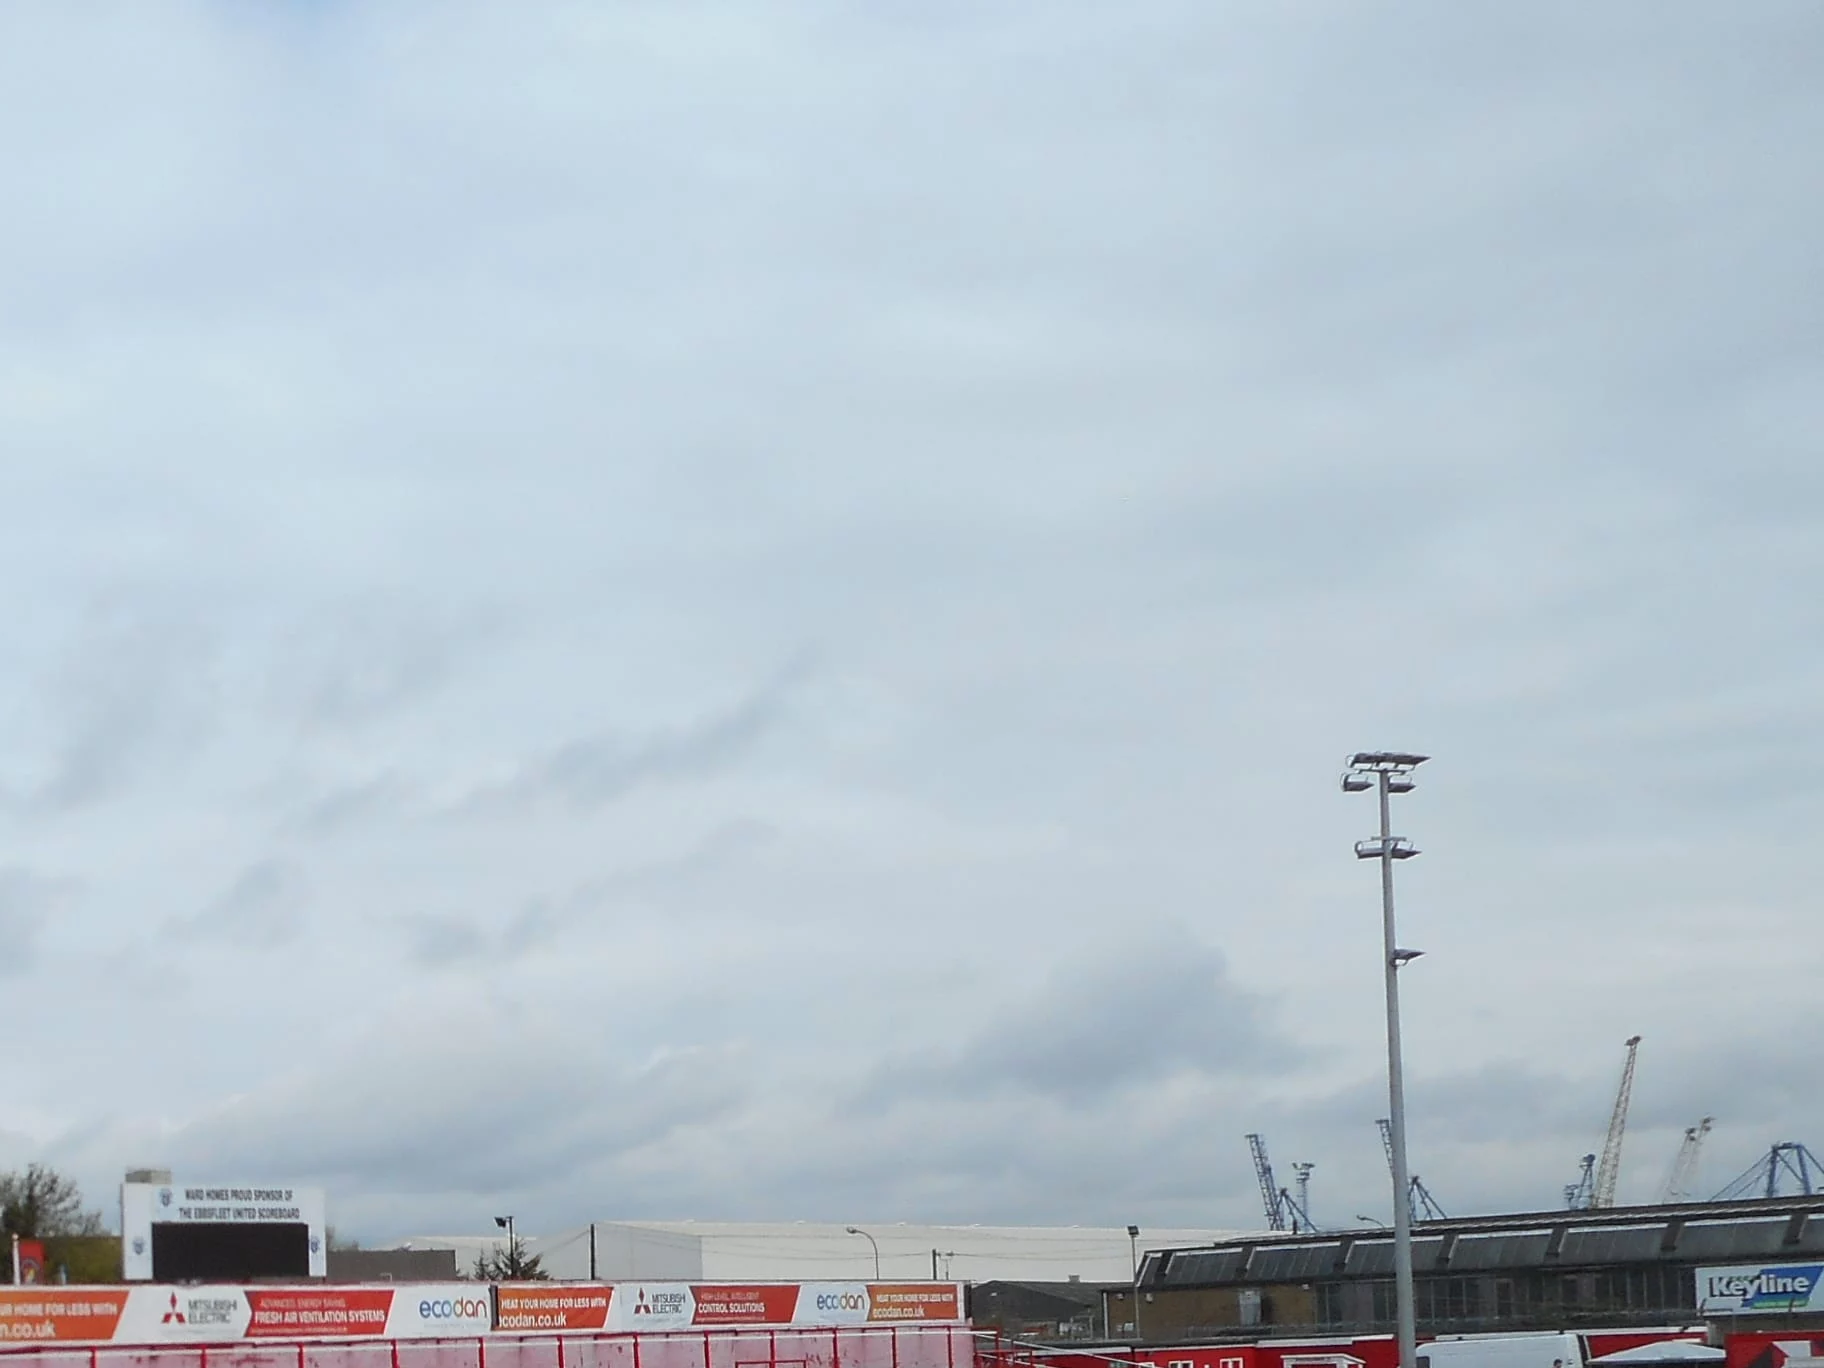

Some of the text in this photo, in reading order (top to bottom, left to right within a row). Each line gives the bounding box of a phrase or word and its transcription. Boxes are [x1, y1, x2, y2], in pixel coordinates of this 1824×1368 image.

[185, 1189, 293, 1200] WARD HOMES PROUD SPONSOR OF
[1709, 1274, 1810, 1300] Keyline
[501, 1297, 606, 1309] HEAT YOUR HOME FOR LESS WITH
[652, 1293, 685, 1303] MITSUBISHI
[817, 1292, 865, 1310] ecodan
[189, 1300, 237, 1311] MITSUBISHI
[420, 1297, 487, 1318] ecodan
[653, 1304, 682, 1314] ELECTRIC
[698, 1302, 765, 1313] CONTROL SOLUTIONS
[189, 1312, 231, 1324] ELECTRIC
[255, 1309, 384, 1323] FRESH AIR VENTILATION SYSTEMS
